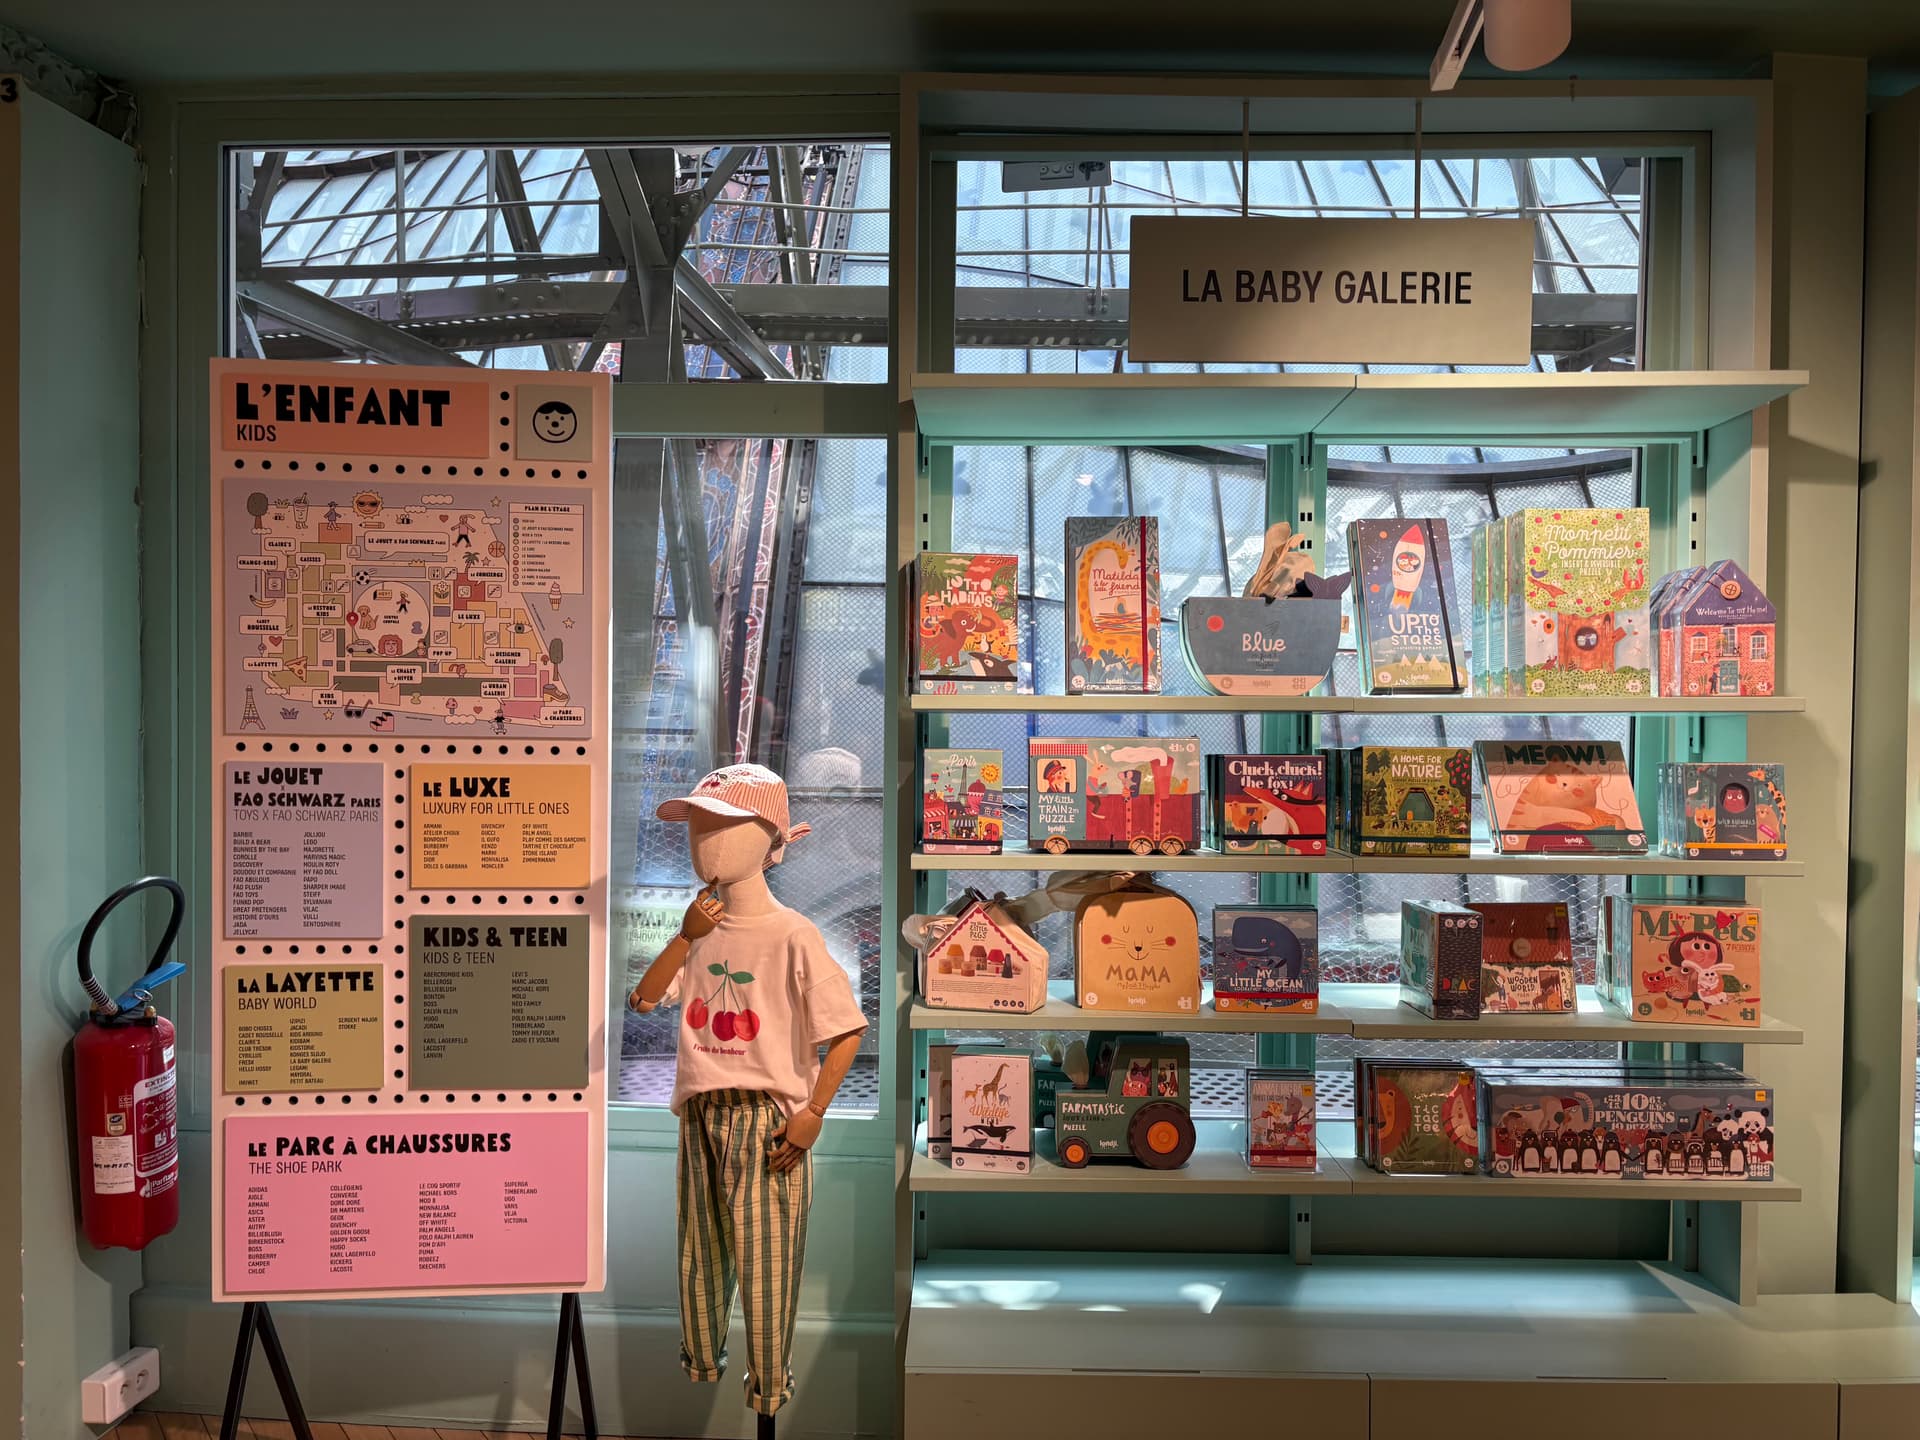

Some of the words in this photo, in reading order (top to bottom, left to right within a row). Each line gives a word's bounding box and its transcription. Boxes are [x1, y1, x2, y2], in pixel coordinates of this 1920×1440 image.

[1183, 270, 1222, 303] LA
[1236, 270, 1323, 303] BABY
[1335, 271, 1472, 304] GALERIE
[236, 383, 450, 426] L'ENFANT
[237, 424, 276, 441] KIDS
[1544, 541, 1634, 560] Pommier
[1093, 569, 1139, 580] Matilda
[947, 576, 992, 591] LOTTO
[1696, 607, 1726, 616] Welcome
[1388, 614, 1420, 634] UP
[1242, 632, 1286, 652] Blue
[949, 754, 976, 766] Paris
[1393, 755, 1399, 763] A
[1504, 744, 1607, 765] MEOW!
[234, 771, 250, 784] LE
[258, 768, 322, 785] JOUET
[1392, 765, 1443, 778] NATURE
[423, 783, 441, 797] LE
[450, 777, 510, 797] LUXE
[1241, 776, 1263, 789] the
[1267, 776, 1293, 790] fox!
[234, 792, 263, 806] FAO
[268, 793, 345, 807] SCHWARZ
[351, 798, 380, 807] PARIS
[1039, 795, 1057, 804] MY
[234, 809, 258, 820] TOYS
[262, 810, 269, 820] X
[273, 810, 292, 820] FAO
[296, 810, 346, 821] SCHWARZ
[350, 810, 378, 822] PARIS
[423, 803, 466, 814] LUXURY
[471, 803, 493, 814] FOR
[497, 803, 534, 814] LITTLE
[539, 803, 569, 814] ONES
[1039, 805, 1068, 814] TRAIN
[1039, 815, 1075, 823] PUZZLE
[1690, 913, 1756, 942] Pets
[424, 927, 479, 947] KIDS
[486, 927, 502, 947] &
[510, 927, 567, 947] TEEN
[424, 952, 448, 964] KIDS
[453, 952, 461, 964] &
[466, 952, 494, 964] TEEN
[1257, 969, 1272, 978] MY
[238, 979, 260, 993] LA
[266, 972, 374, 992] LAYETTE
[1266, 979, 1303, 988] OCEAN
[238, 998, 269, 1010] BABY
[273, 997, 316, 1009] WORLD
[1038, 1080, 1055, 1089] FAR
[1622, 1093, 1648, 1110] 10
[1594, 1111, 1675, 1123] PENGUINS
[1626, 1123, 1664, 1132] puzzles
[248, 1143, 267, 1157] LE
[276, 1136, 334, 1156] PARC
[343, 1137, 357, 1155] À
[366, 1133, 511, 1154] CHAUSSURES
[248, 1162, 272, 1174] THE
[276, 1161, 307, 1174] SHOE
[312, 1160, 342, 1173] PARK
